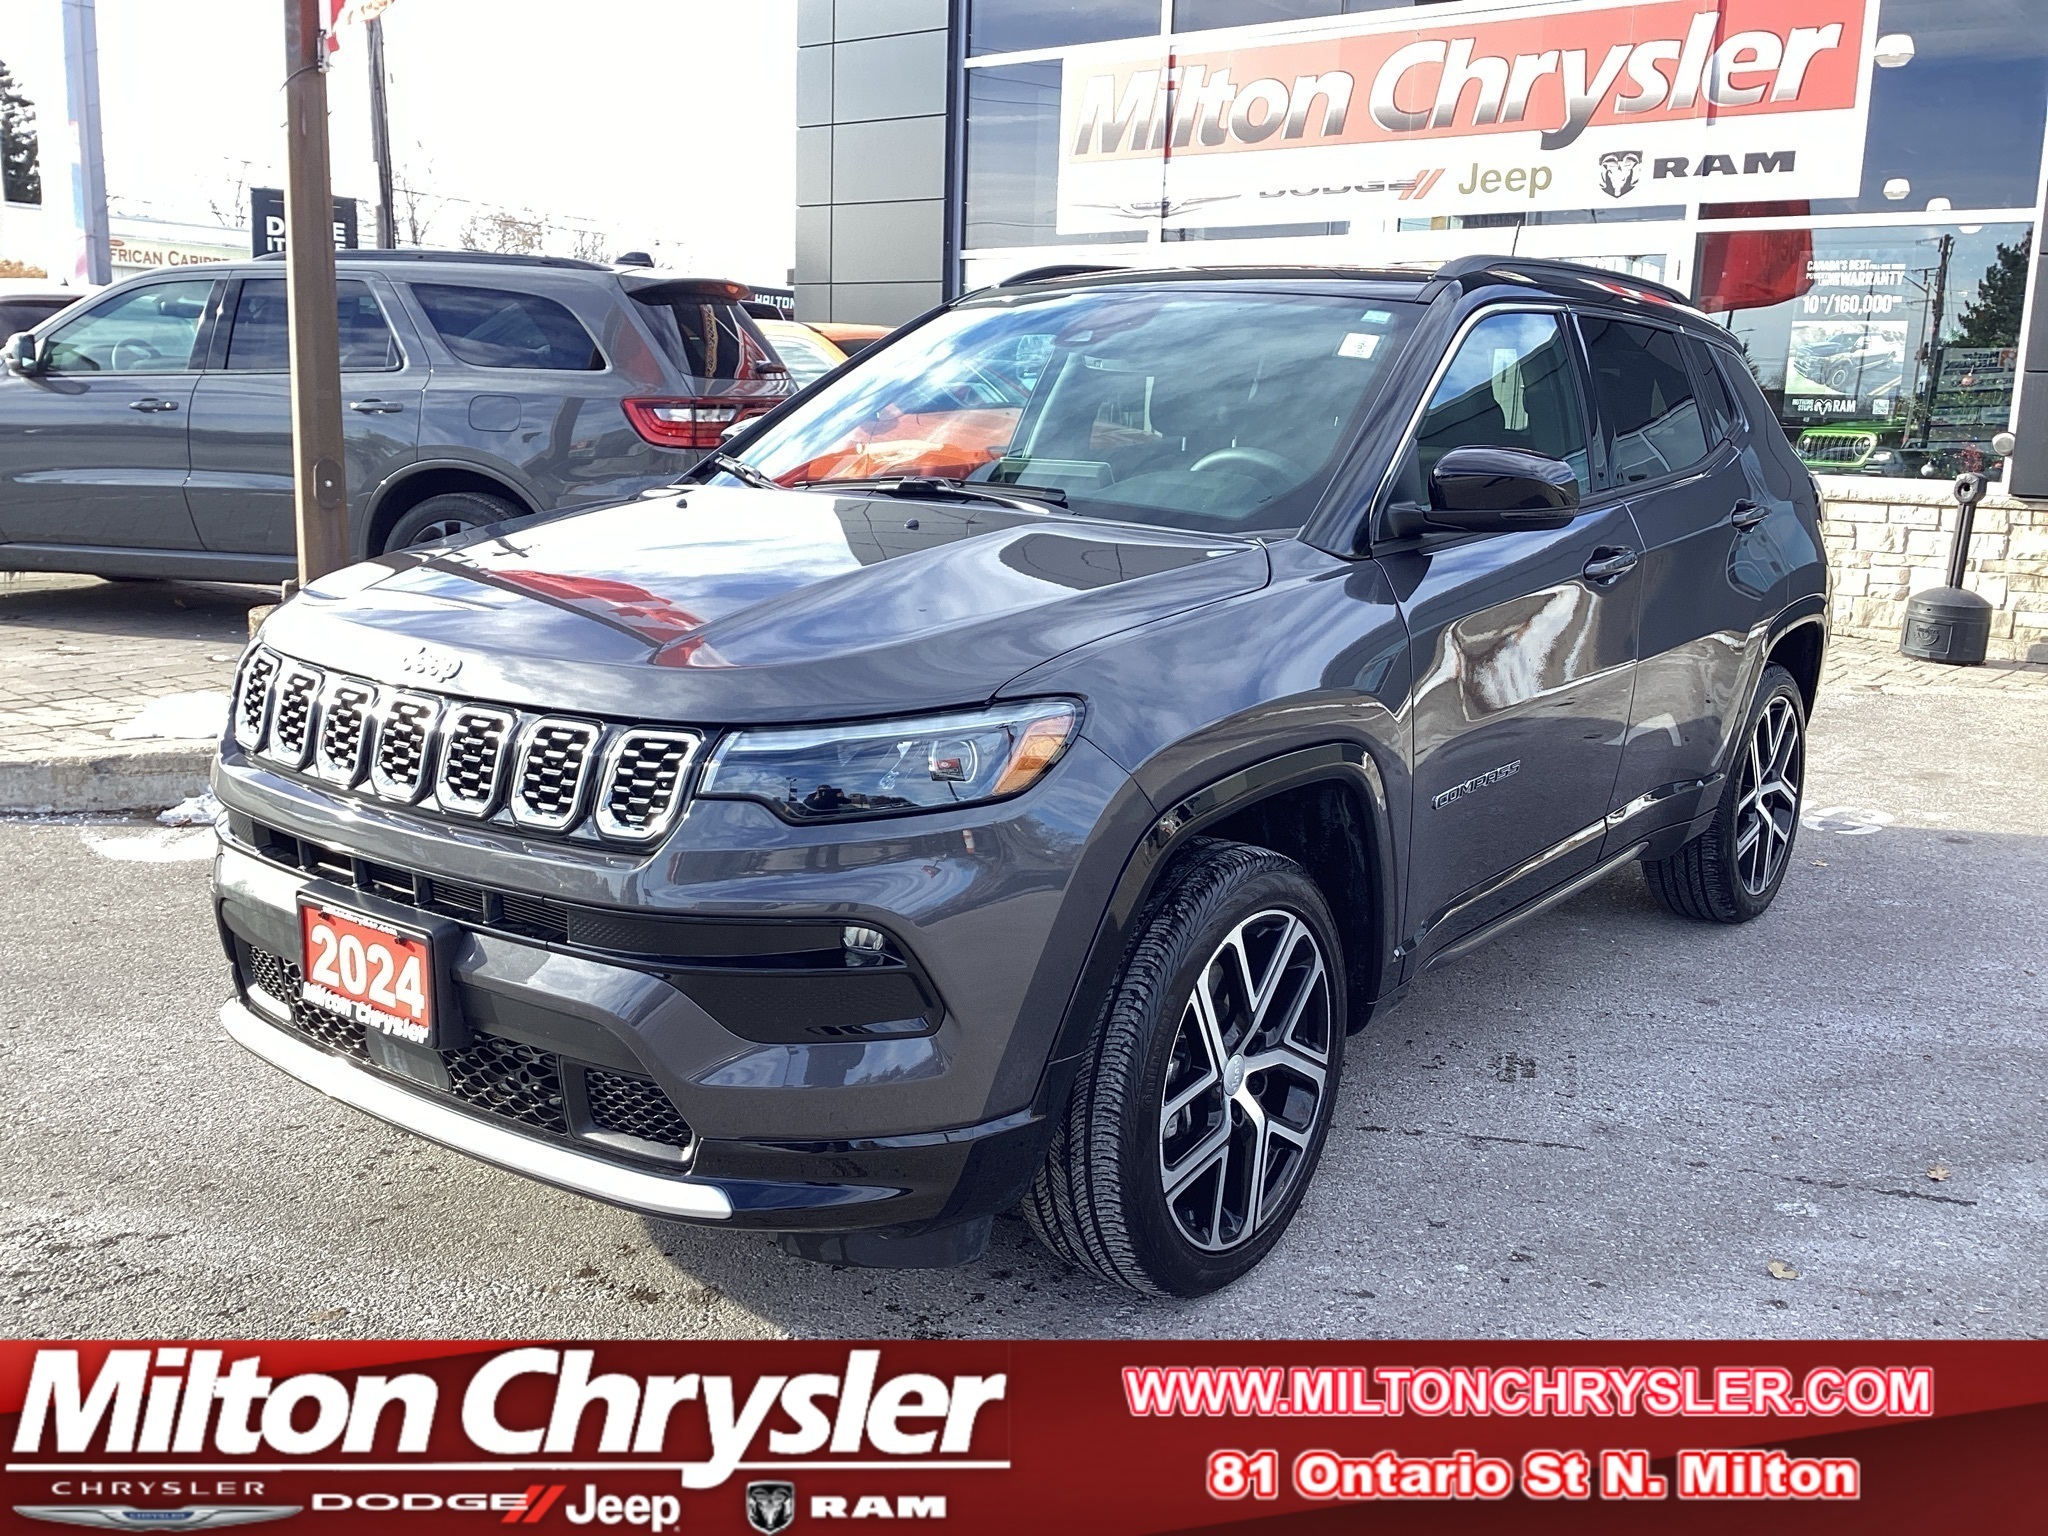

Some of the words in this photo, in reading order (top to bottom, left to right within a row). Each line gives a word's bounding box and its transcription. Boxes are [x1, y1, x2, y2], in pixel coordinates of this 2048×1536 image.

[1074, 64, 1355, 156] Milton
[1368, 12, 1843, 151] Chrysler
[1458, 163, 1553, 198] Jeep
[1653, 150, 1797, 179] RAM
[1841, 271, 1906, 286] WARRANTY
[1833, 400, 1857, 413] RAM
[1434, 759, 1521, 810] COMPASS
[311, 923, 425, 1019] 2024
[355, 1001, 429, 1044] Chrysler
